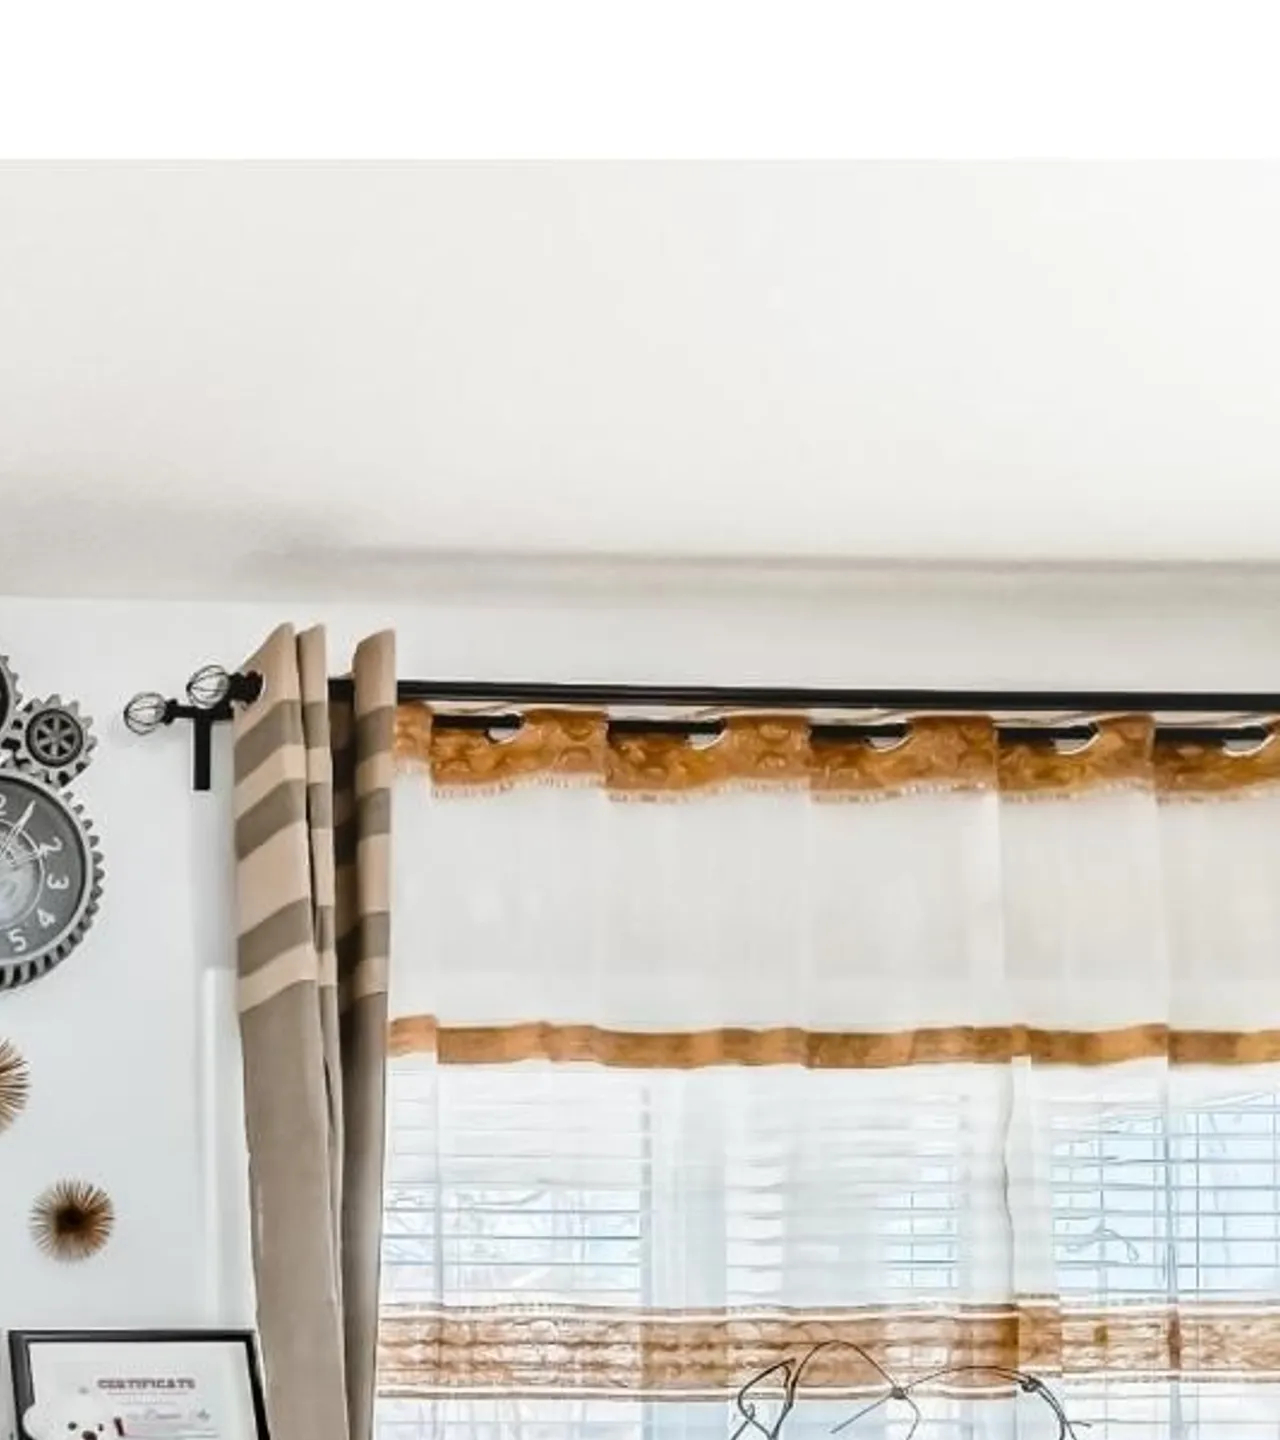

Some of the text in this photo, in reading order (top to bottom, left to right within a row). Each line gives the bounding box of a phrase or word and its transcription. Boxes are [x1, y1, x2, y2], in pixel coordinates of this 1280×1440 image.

[47, 873, 69, 889] 3
[37, 908, 56, 927] 4
[9, 928, 26, 951] 5
[97, 1378, 197, 1390] CERTIFICATE
